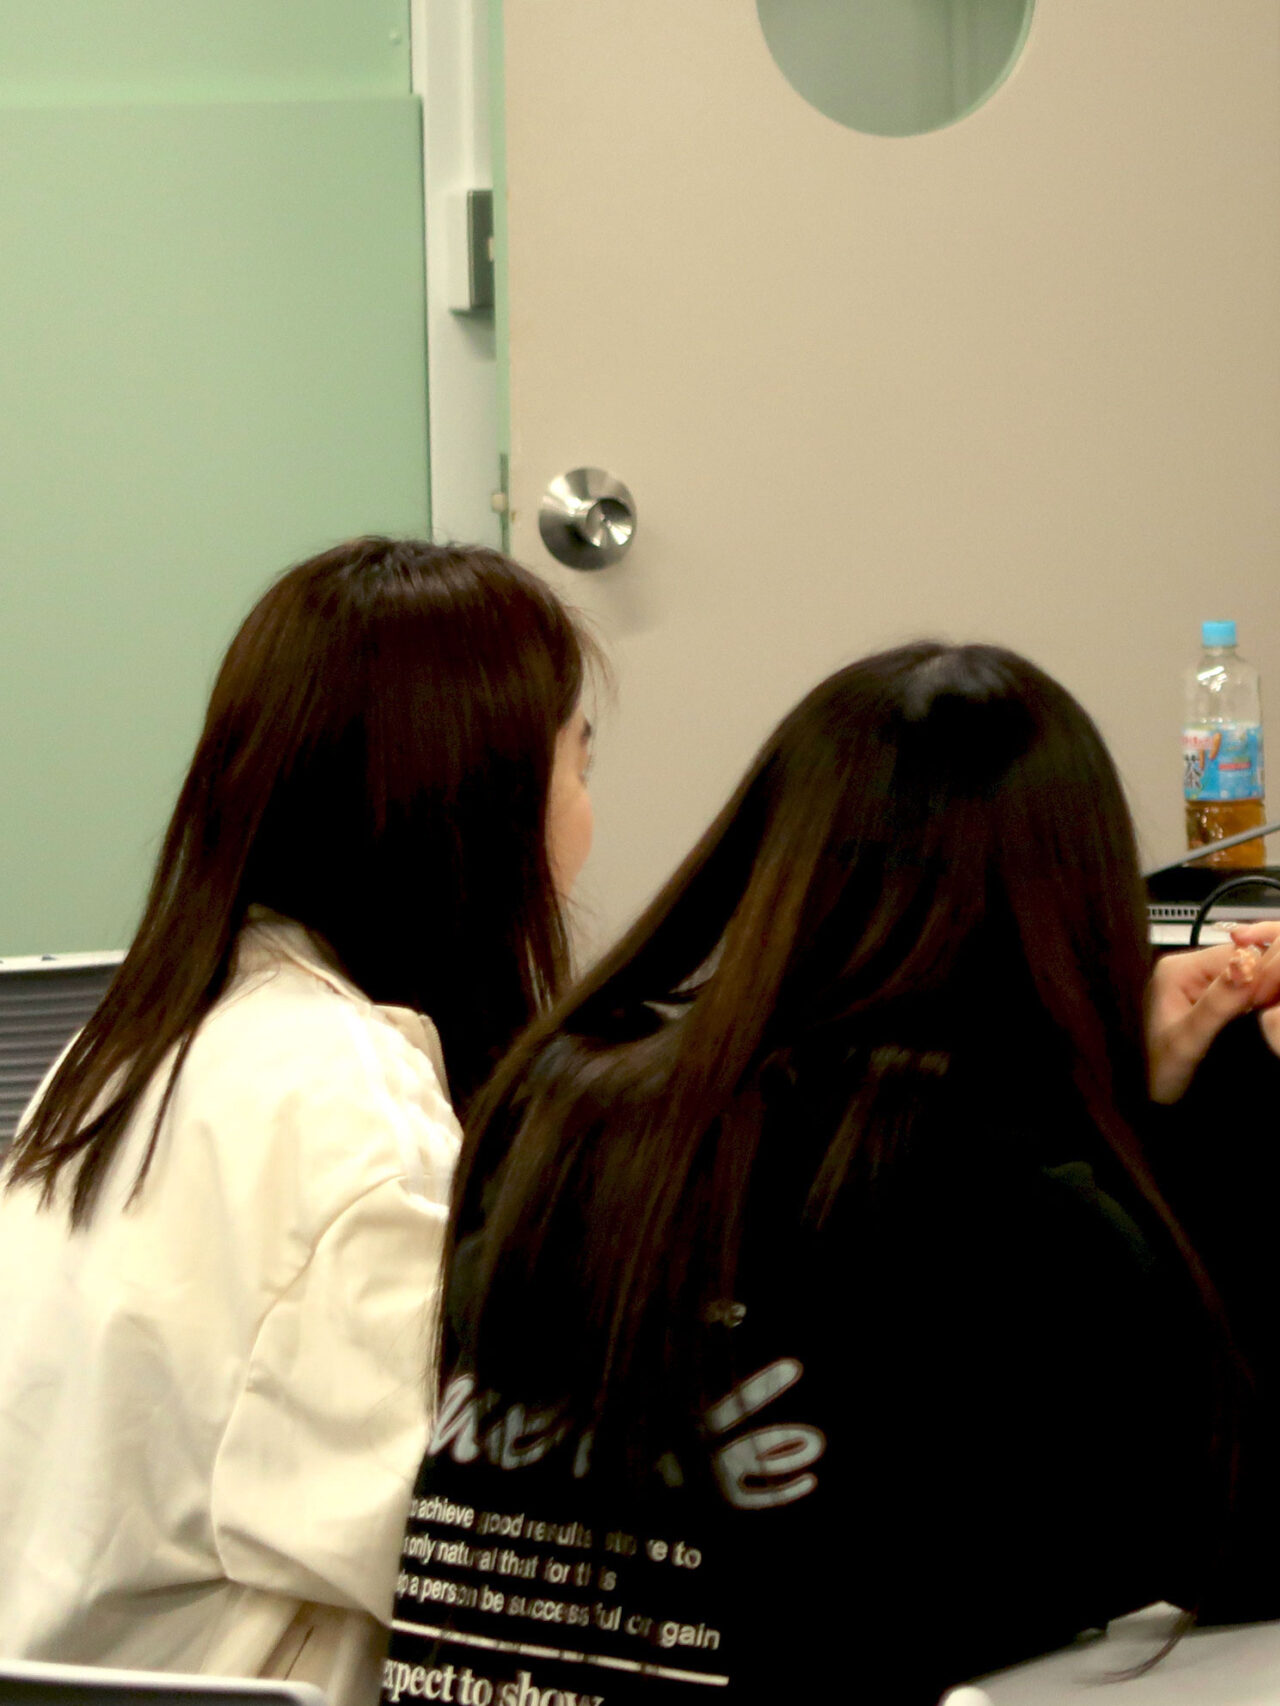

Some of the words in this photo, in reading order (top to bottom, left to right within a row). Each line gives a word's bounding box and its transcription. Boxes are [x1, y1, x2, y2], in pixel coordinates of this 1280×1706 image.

[409, 1533, 436, 1565] only
[419, 1497, 474, 1529] achieve
[673, 1541, 702, 1569] to
[409, 1576, 419, 1596] a
[480, 1585, 505, 1613] be
[659, 1623, 721, 1650] gain
[382, 1658, 457, 1703] xpect
[460, 1668, 494, 1706] to
